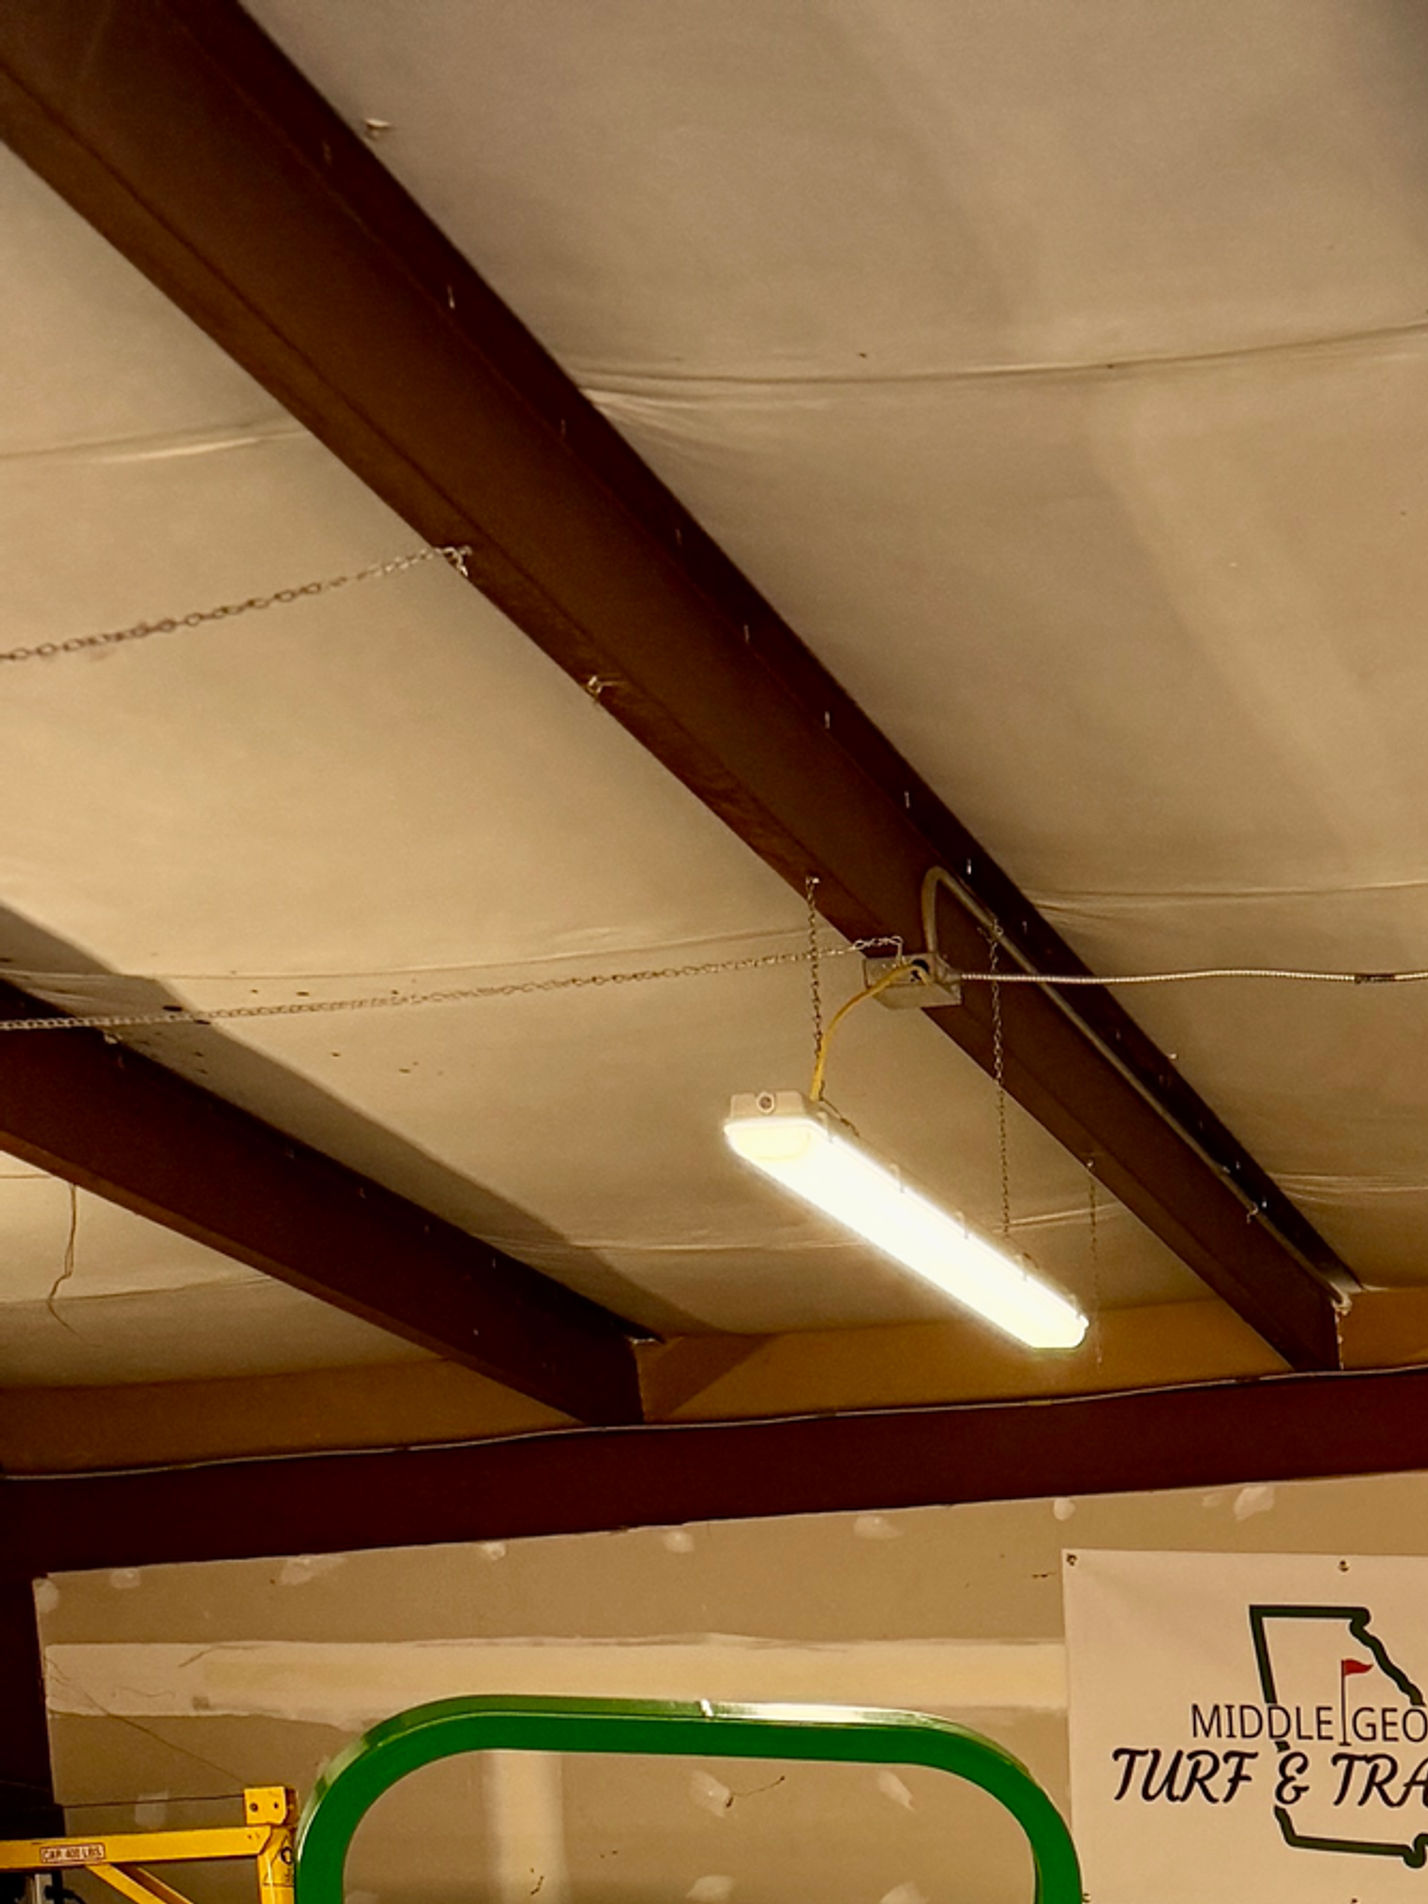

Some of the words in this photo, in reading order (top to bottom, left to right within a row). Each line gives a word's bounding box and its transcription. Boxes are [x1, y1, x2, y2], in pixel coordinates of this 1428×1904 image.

[1190, 1702, 1334, 1742] MIDDLE
[1112, 1748, 1259, 1804] TURF
[1274, 1751, 1310, 1806] &
